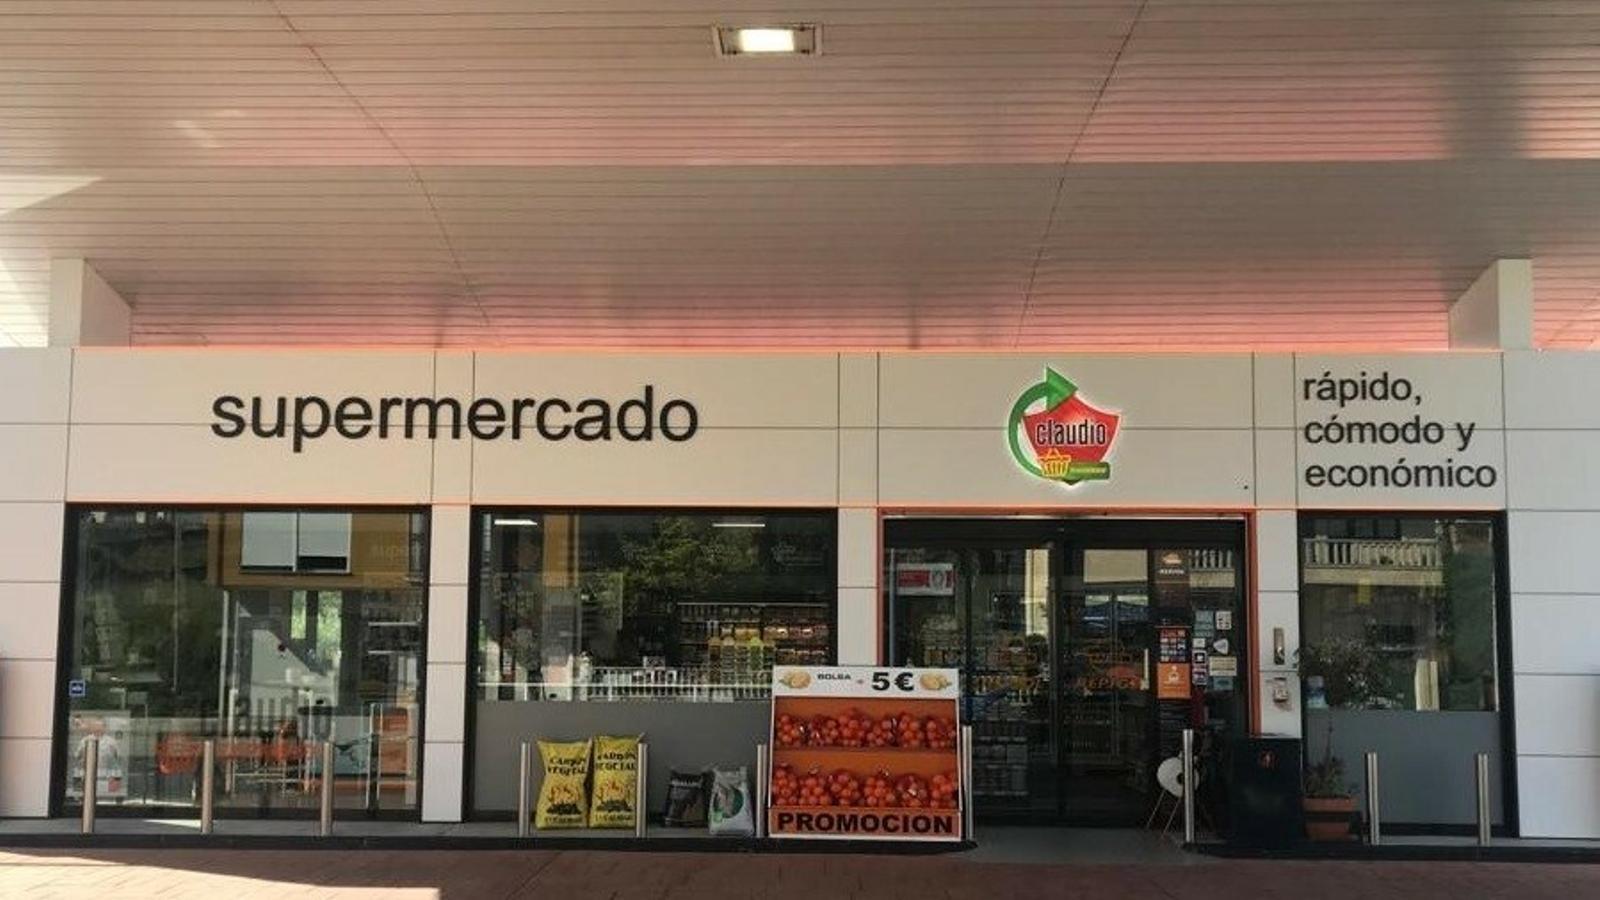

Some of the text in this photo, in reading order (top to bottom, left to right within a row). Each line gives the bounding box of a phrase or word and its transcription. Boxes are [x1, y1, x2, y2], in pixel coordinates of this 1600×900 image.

[1303, 371, 1421, 408] rápido,
[211, 385, 698, 453] supermercado
[1036, 418, 1106, 446] claudio
[1304, 415, 1476, 451] cómodo y
[1305, 458, 1497, 488] económico
[777, 812, 954, 834] PROMOCION
